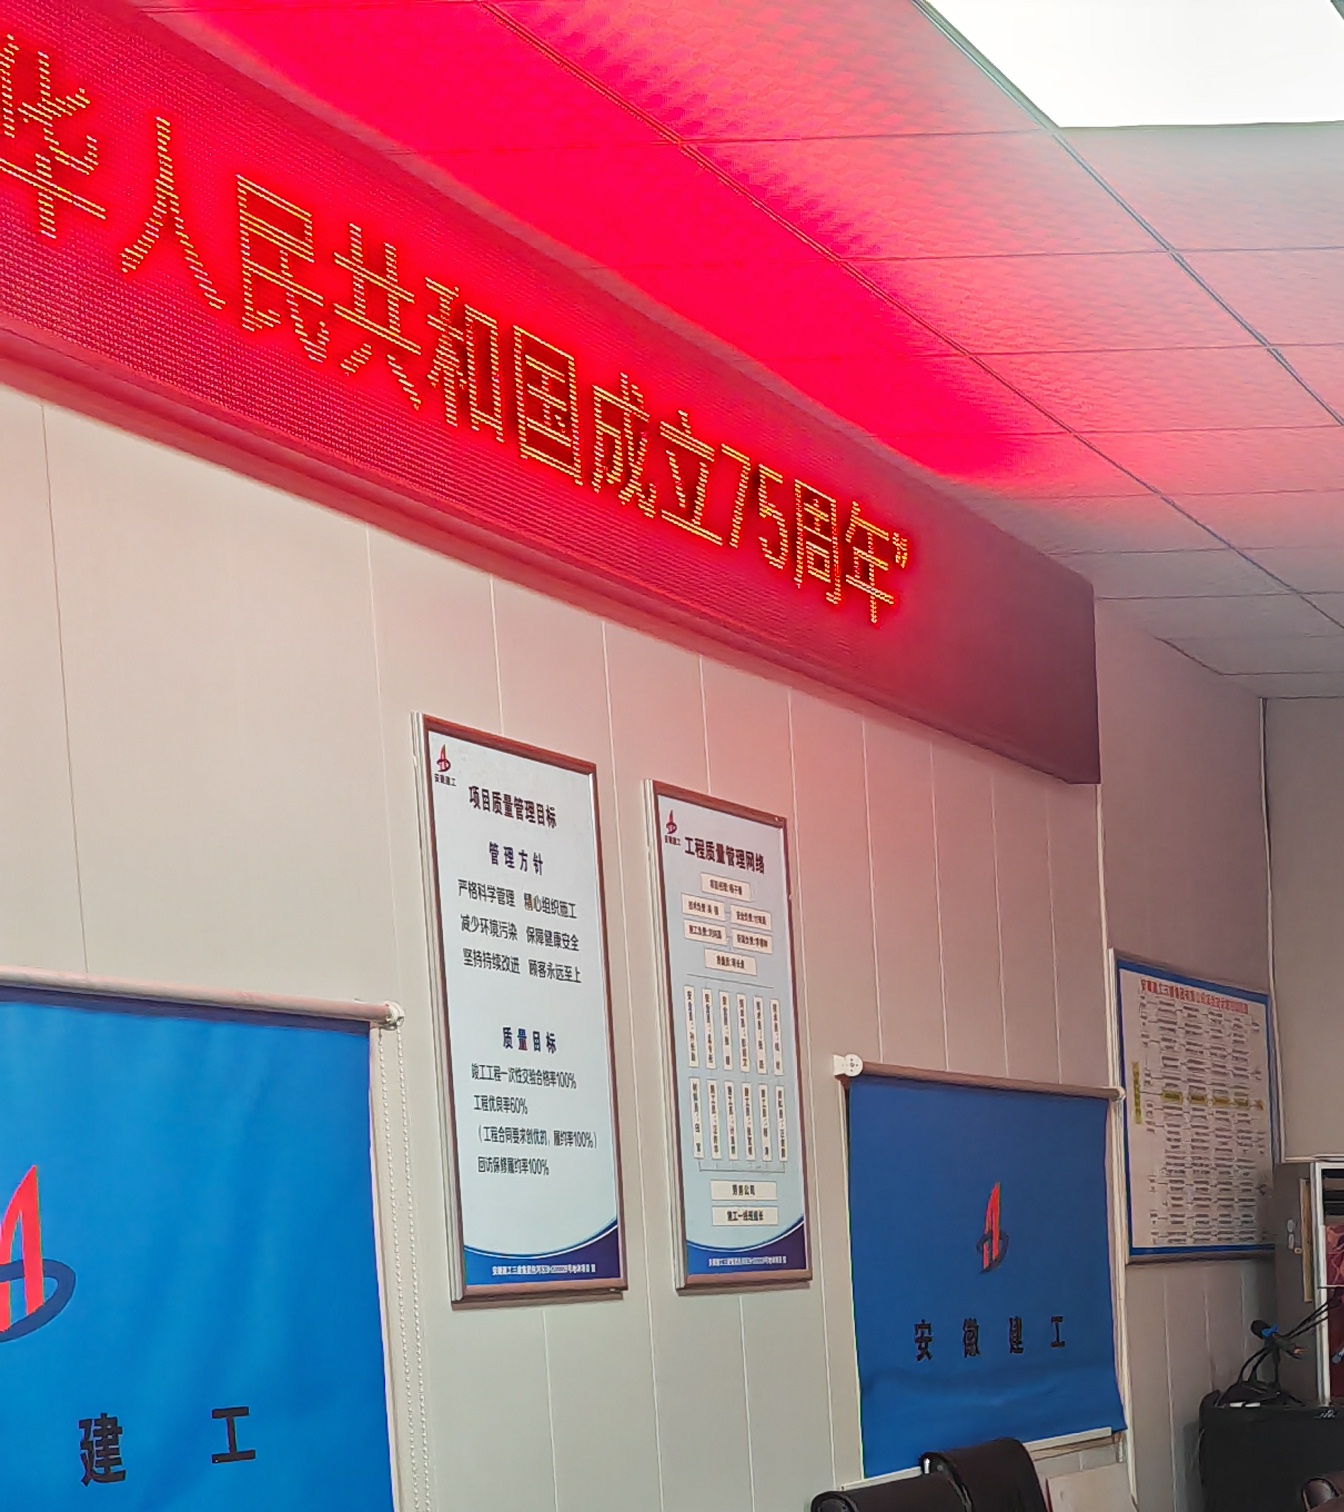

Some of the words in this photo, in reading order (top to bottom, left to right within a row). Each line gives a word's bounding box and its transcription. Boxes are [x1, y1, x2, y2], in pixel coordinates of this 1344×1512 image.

[468, 785, 557, 828] 项目质量管理目标
[489, 841, 543, 875] 管理方针
[684, 836, 765, 874] 工程质量管理网络
[457, 879, 515, 908] 严格科学管理
[524, 892, 577, 919] 精心组织施工
[460, 914, 518, 941] 减少环境污染
[526, 926, 580, 951] 保障健康安全
[463, 947, 521, 974] 坚持持续改进
[528, 959, 582, 983] 顾客永远至上
[502, 1026, 558, 1054] 质量目标
[914, 1316, 1066, 1362] 安徽建工
[78, 1406, 257, 1486] 建工
